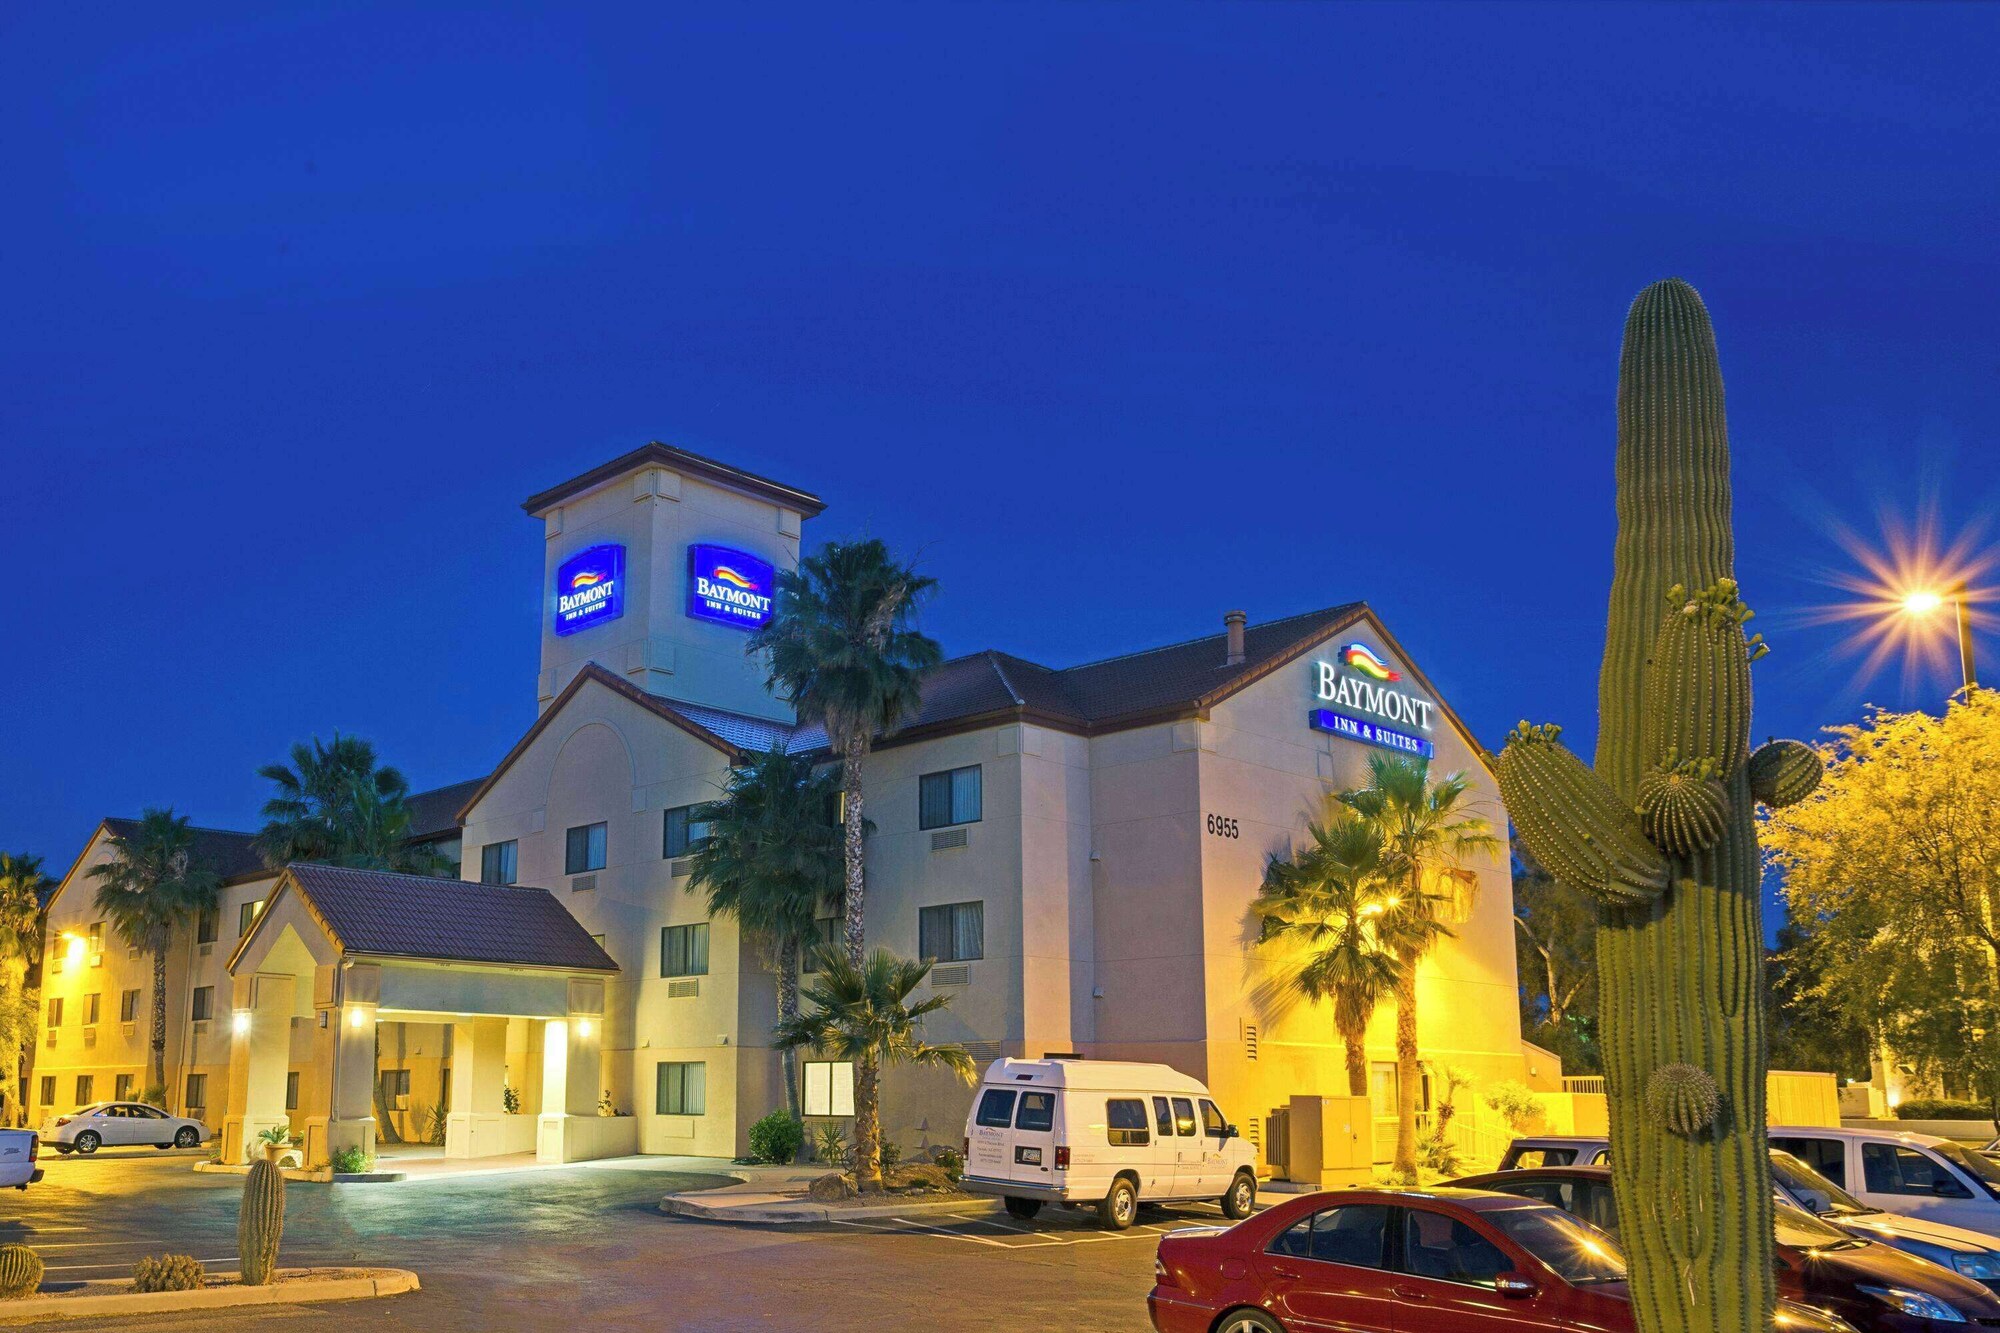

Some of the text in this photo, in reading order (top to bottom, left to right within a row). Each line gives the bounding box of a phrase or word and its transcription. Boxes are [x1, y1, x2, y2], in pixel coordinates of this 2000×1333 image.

[559, 580, 614, 613] BAYMONT
[697, 577, 771, 611] BAYMONT
[706, 600, 722, 609] INN
[732, 607, 761, 619] SUITES
[565, 611, 577, 621] INN
[584, 601, 606, 614] SUITES
[1317, 661, 1432, 731] BAYMONT
[1334, 716, 1418, 751] INN & SUITES
[1207, 813, 1239, 839] 6955
